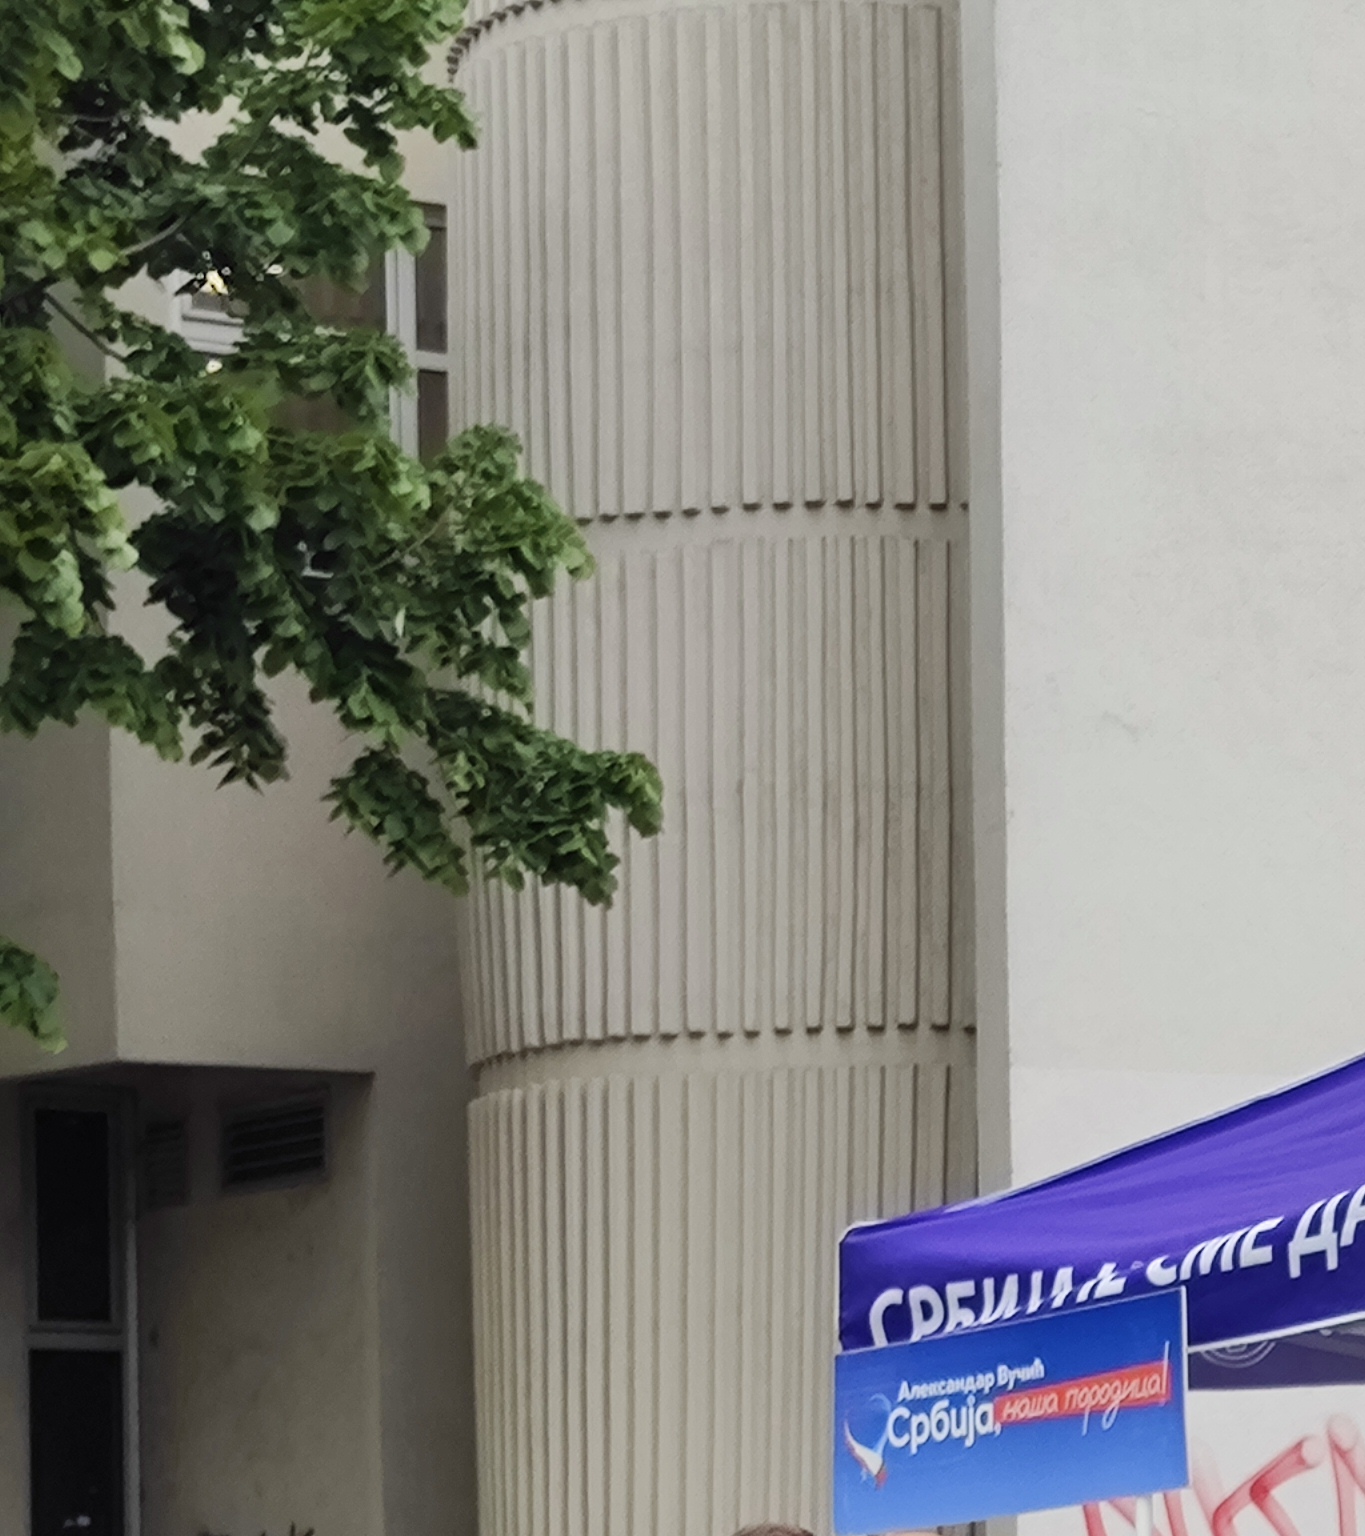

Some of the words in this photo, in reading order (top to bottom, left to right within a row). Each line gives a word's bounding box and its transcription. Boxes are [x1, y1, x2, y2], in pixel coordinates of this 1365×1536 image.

[897, 1372, 995, 1403] Александар
[997, 1357, 1045, 1390] Вучић
[887, 1394, 1002, 1454] Србија,
[1003, 1395, 1059, 1421] наша
